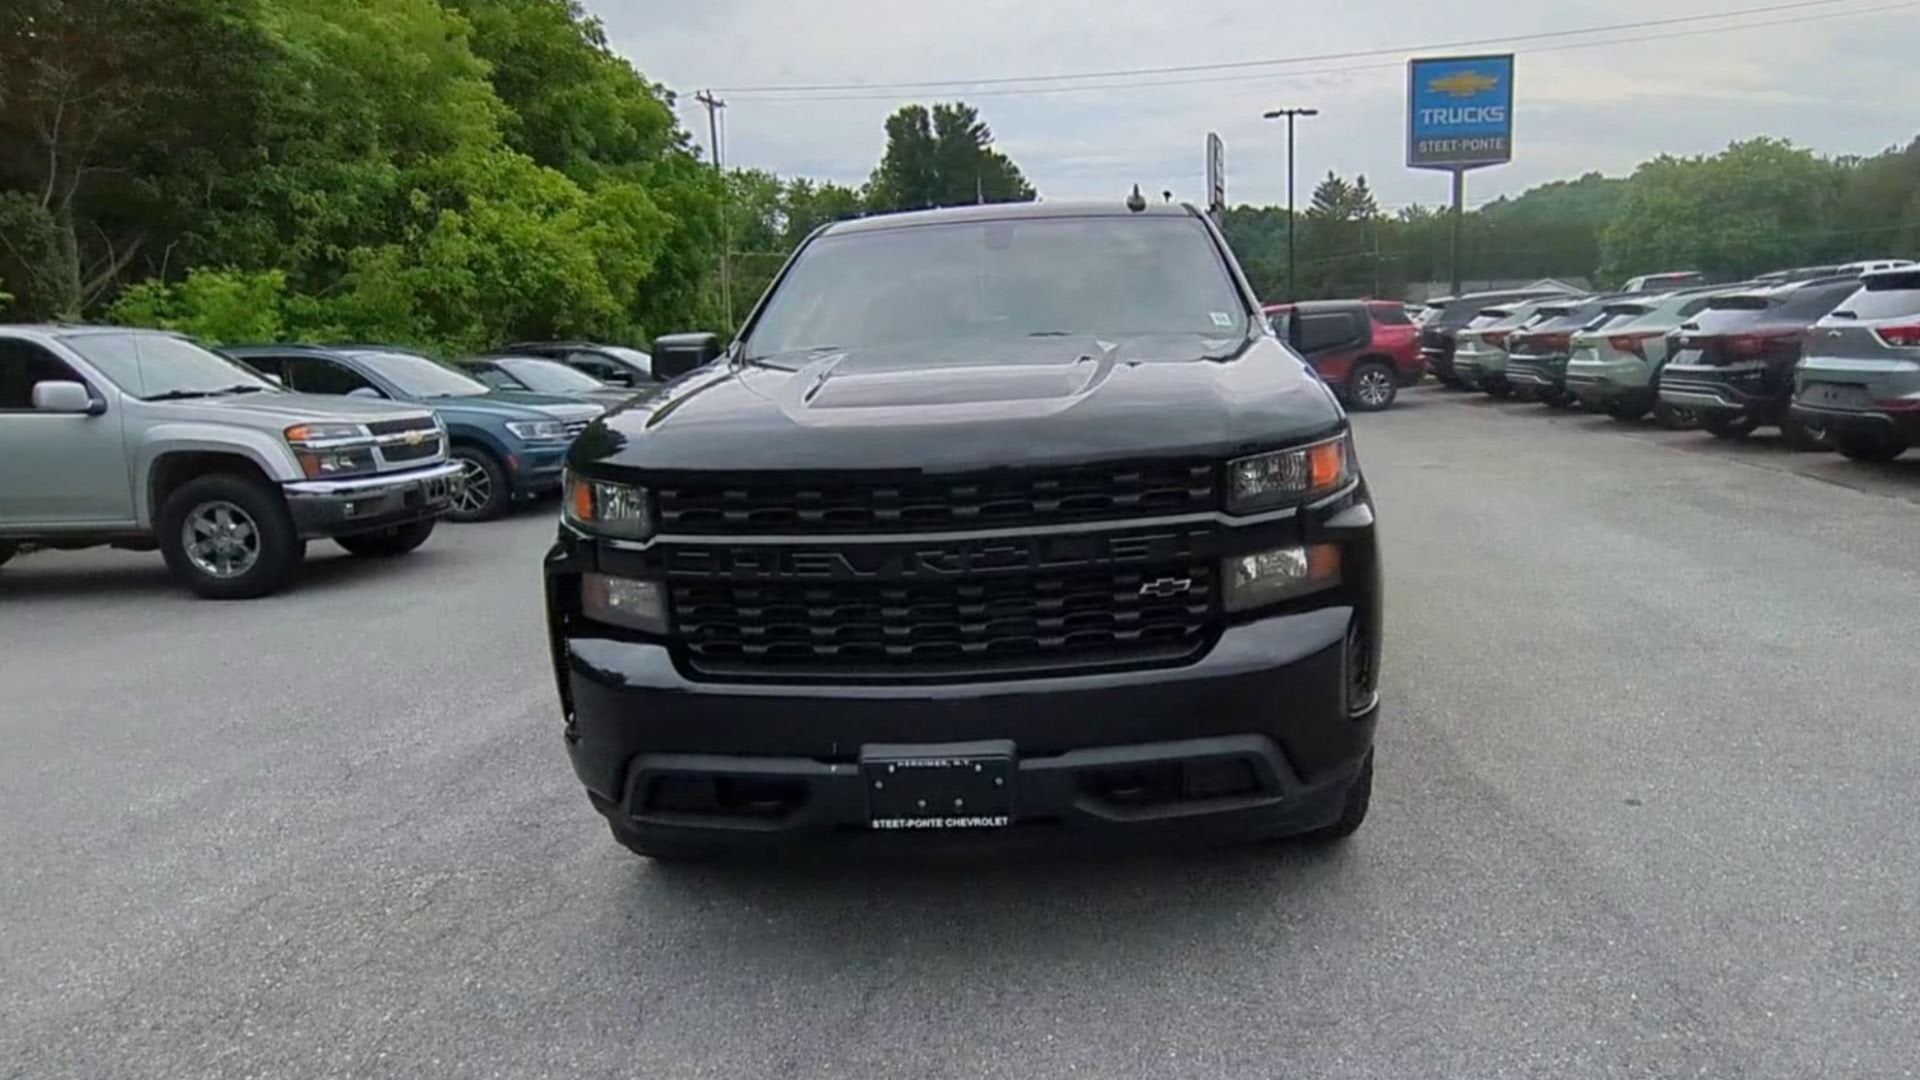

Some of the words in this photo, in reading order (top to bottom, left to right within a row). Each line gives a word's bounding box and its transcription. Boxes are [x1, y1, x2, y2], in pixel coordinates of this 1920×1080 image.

[1420, 106, 1505, 125] TRUCKS
[1419, 137, 1505, 153] STEET-PONTE
[872, 818, 943, 829] STEET-PONTE
[945, 816, 1008, 828] CHEVROLET
